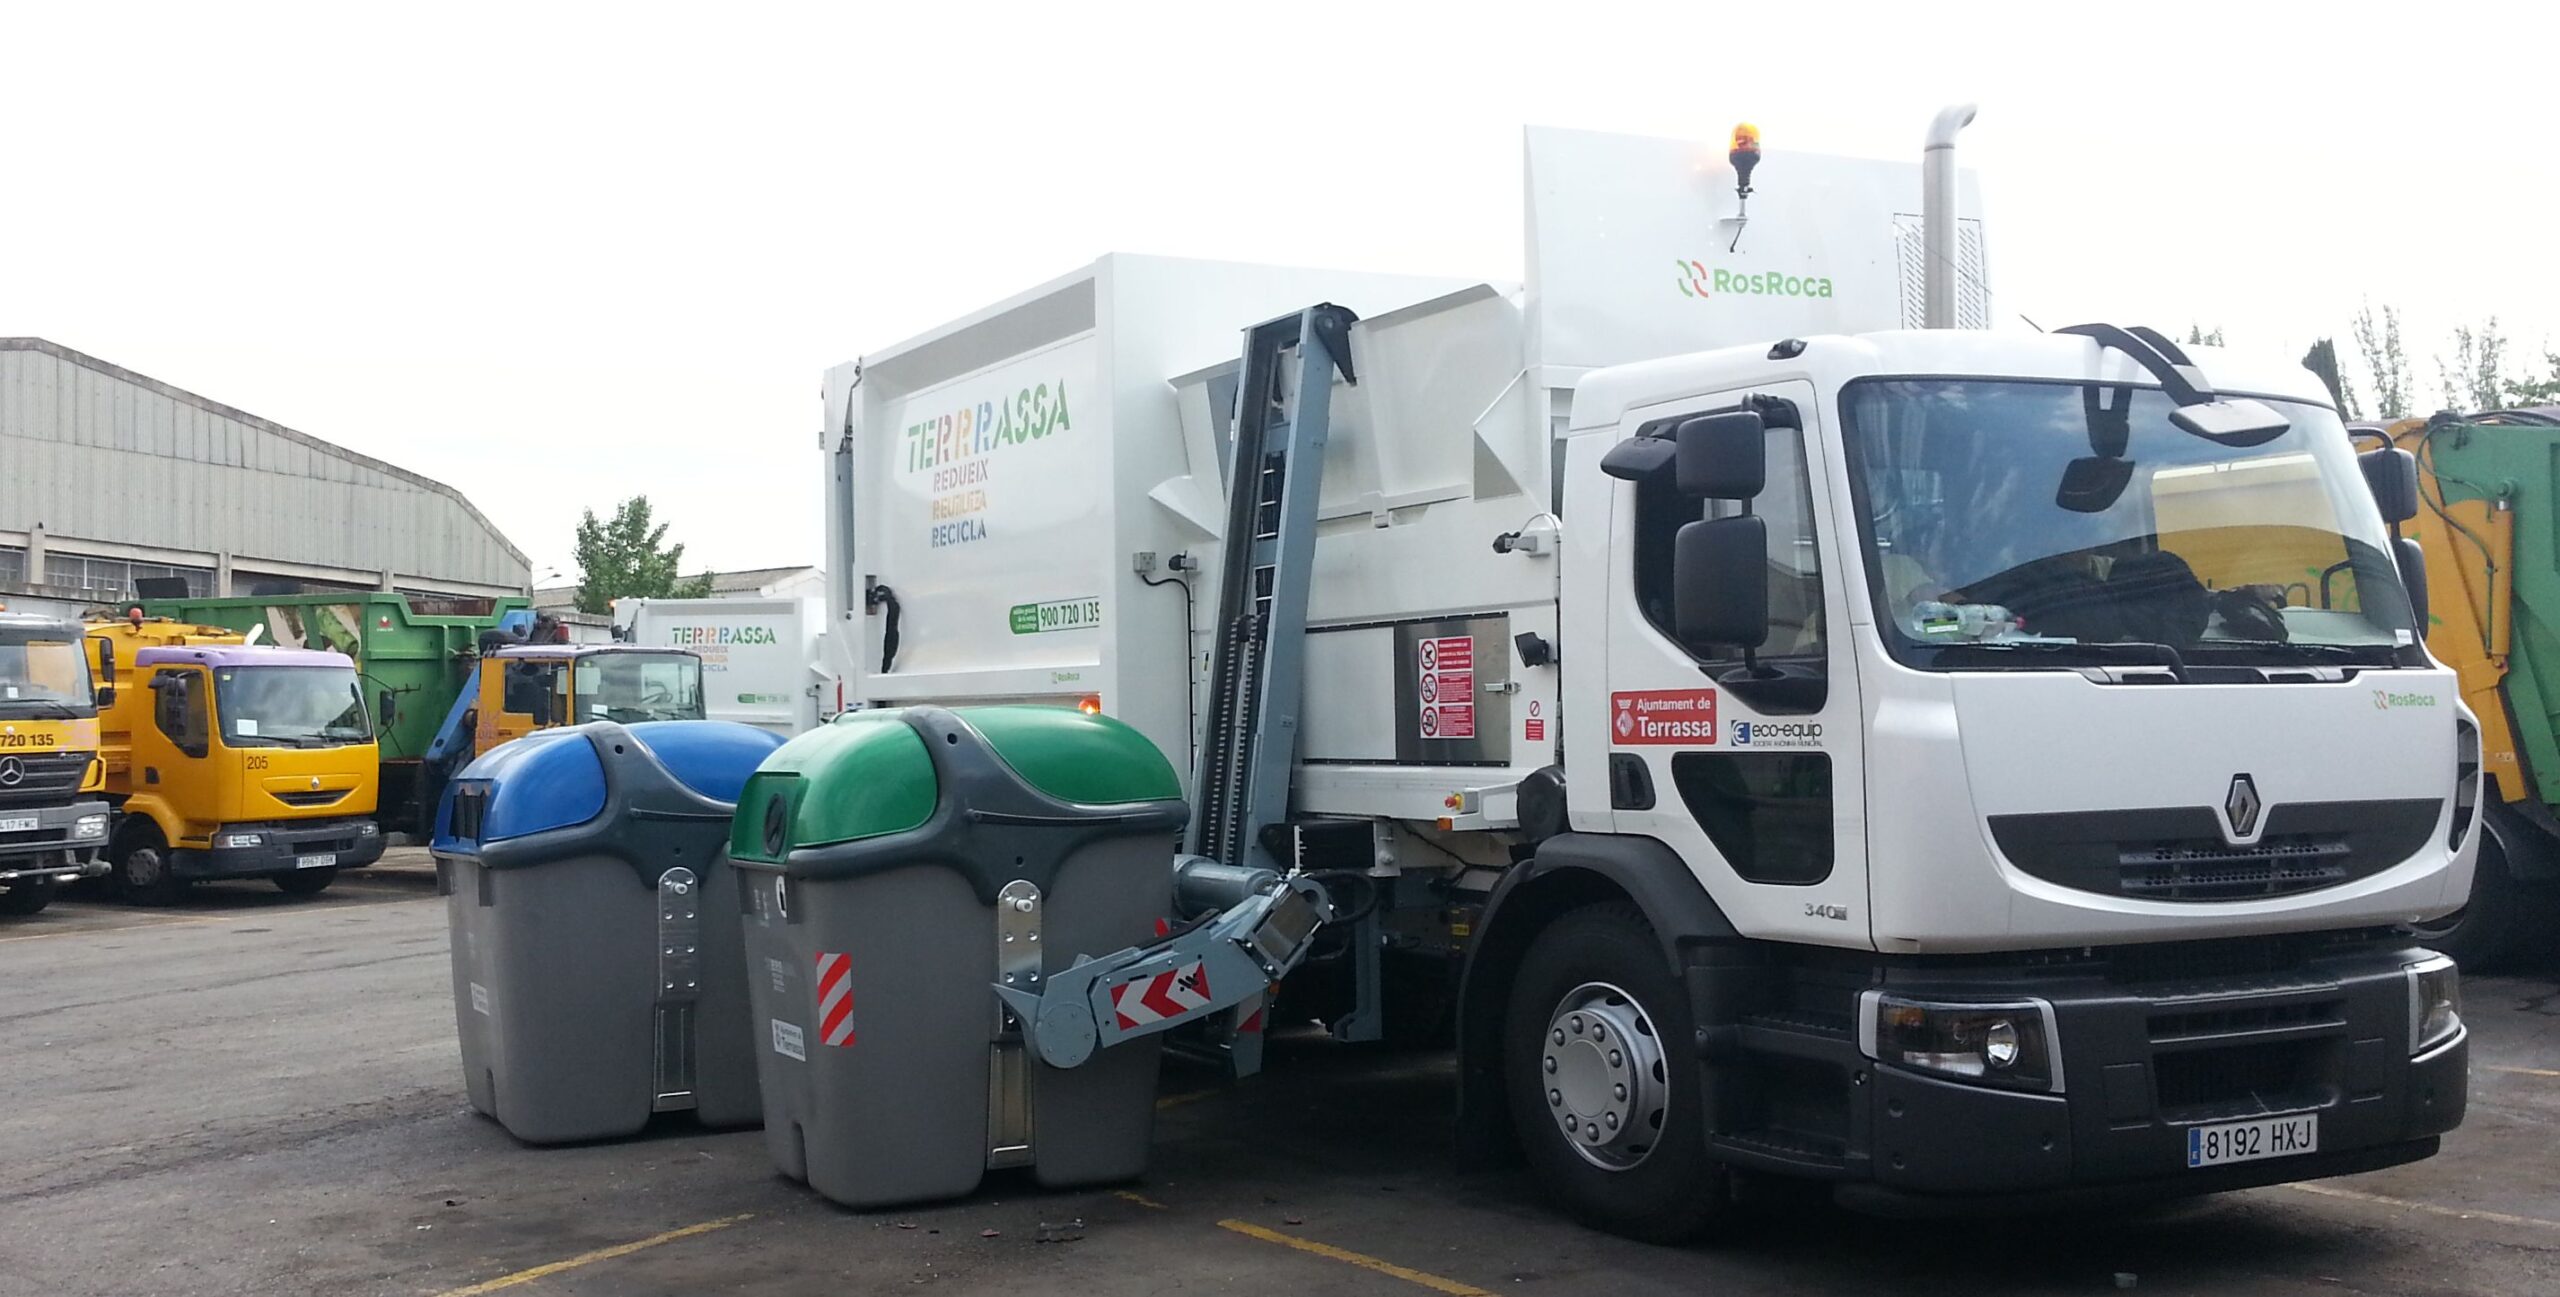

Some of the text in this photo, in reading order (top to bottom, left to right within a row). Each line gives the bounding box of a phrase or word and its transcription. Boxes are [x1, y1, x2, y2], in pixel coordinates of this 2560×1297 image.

[1713, 268, 1833, 298] RosRoca
[907, 377, 1071, 473] TERRRASSA
[933, 458, 989, 493] REDUEIX
[931, 517, 987, 548] RECICLA
[1041, 606, 1058, 627] 900
[1061, 603, 1079, 625] 720
[1083, 601, 1100, 623] 135
[672, 626, 777, 644] TERRRASSA
[1637, 696, 1711, 713] Ajuntament de
[2388, 693, 2436, 707] RosRoca
[1638, 715, 1712, 738] Terrassa
[1752, 720, 1823, 741] eco-equip
[0, 733, 54, 747] 720 135
[247, 756, 269, 770] 205
[1804, 902, 1836, 919] 340
[2206, 1120, 2311, 1160] 8192 HXJ
